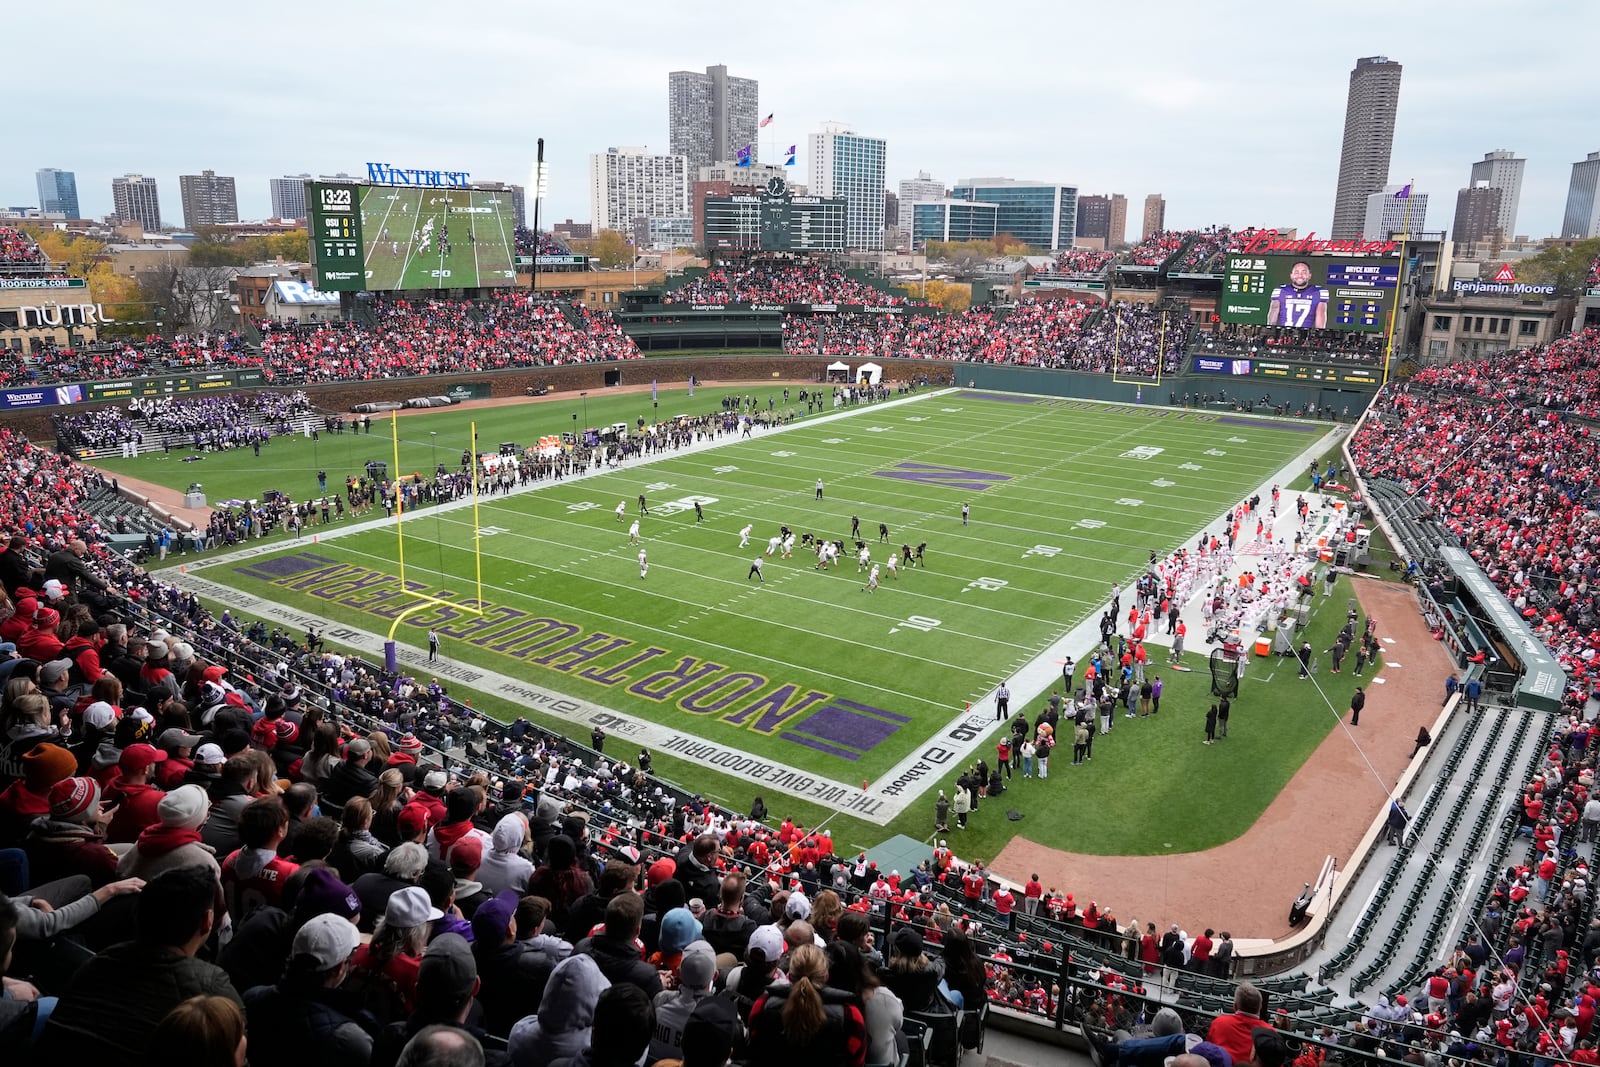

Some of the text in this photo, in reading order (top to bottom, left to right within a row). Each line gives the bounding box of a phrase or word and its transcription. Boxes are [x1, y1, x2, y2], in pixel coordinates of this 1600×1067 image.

[366, 162, 470, 187] WINTRUST
[321, 189, 351, 204] 13:23
[325, 218, 349, 227] OSU 0
[343, 228, 349, 237] 0
[1236, 228, 1399, 255] Budweiser
[337, 249, 344, 257] 10
[349, 249, 356, 257] 19
[1231, 259, 1252, 269] 13:23
[431, 270, 451, 278] 20
[1453, 281, 1554, 295] Benjamin Moore
[864, 305, 903, 314] Budweiser
[1285, 303, 1312, 327] 17
[7, 392, 43, 401] WINTRUST
[871, 462, 1014, 491] N
[1026, 544, 1063, 558] 30
[968, 577, 1009, 591] 20
[898, 615, 943, 632] 10
[270, 562, 834, 737] NORTHWESTERN
[500, 683, 555, 704] Abbott
[659, 735, 884, 816] THE WE GIVE BLOOD DRIVE
[881, 760, 932, 796] Abbott
[873, 889, 886, 898] 33
